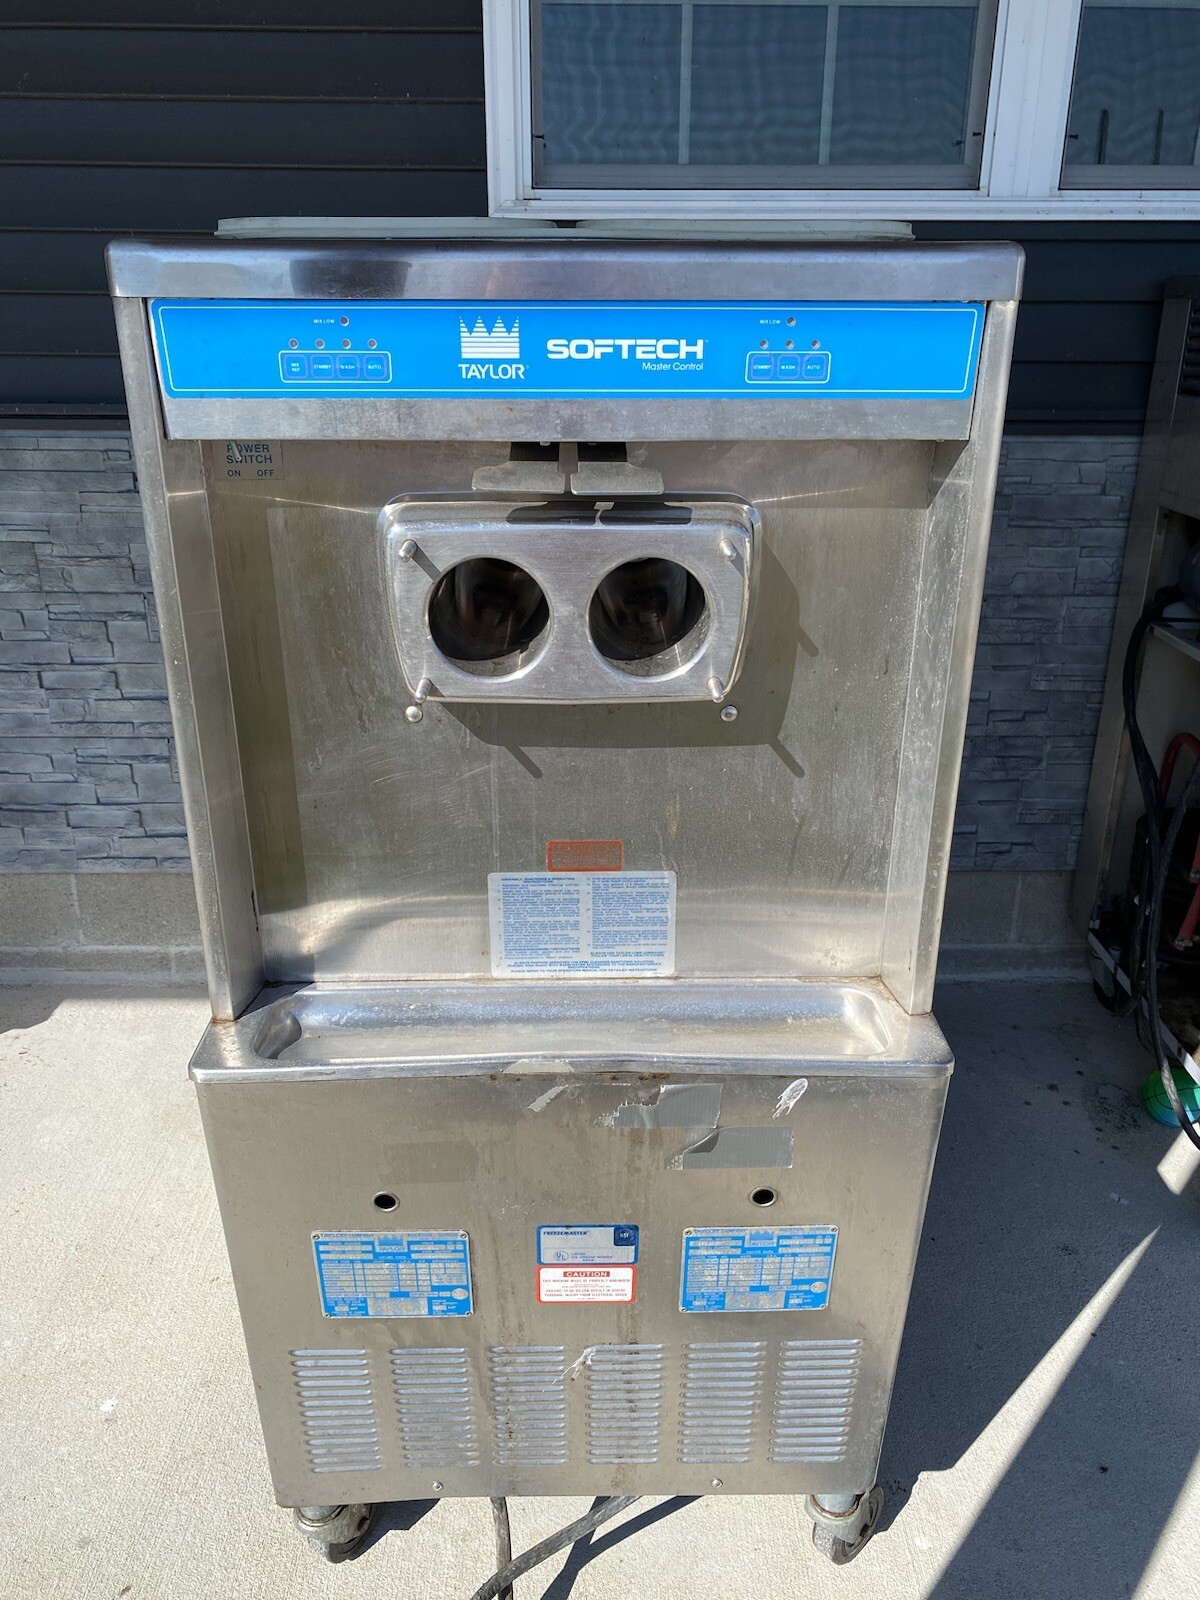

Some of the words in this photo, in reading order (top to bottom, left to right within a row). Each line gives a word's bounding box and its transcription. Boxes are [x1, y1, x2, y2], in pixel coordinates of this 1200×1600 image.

[546, 338, 704, 360] SOFTECH
[642, 361, 671, 371] Master
[672, 361, 704, 371] Control
[457, 363, 525, 380] TAYLOR
[226, 443, 270, 453] POWER
[227, 469, 241, 477] ON
[256, 469, 274, 477] OFF
